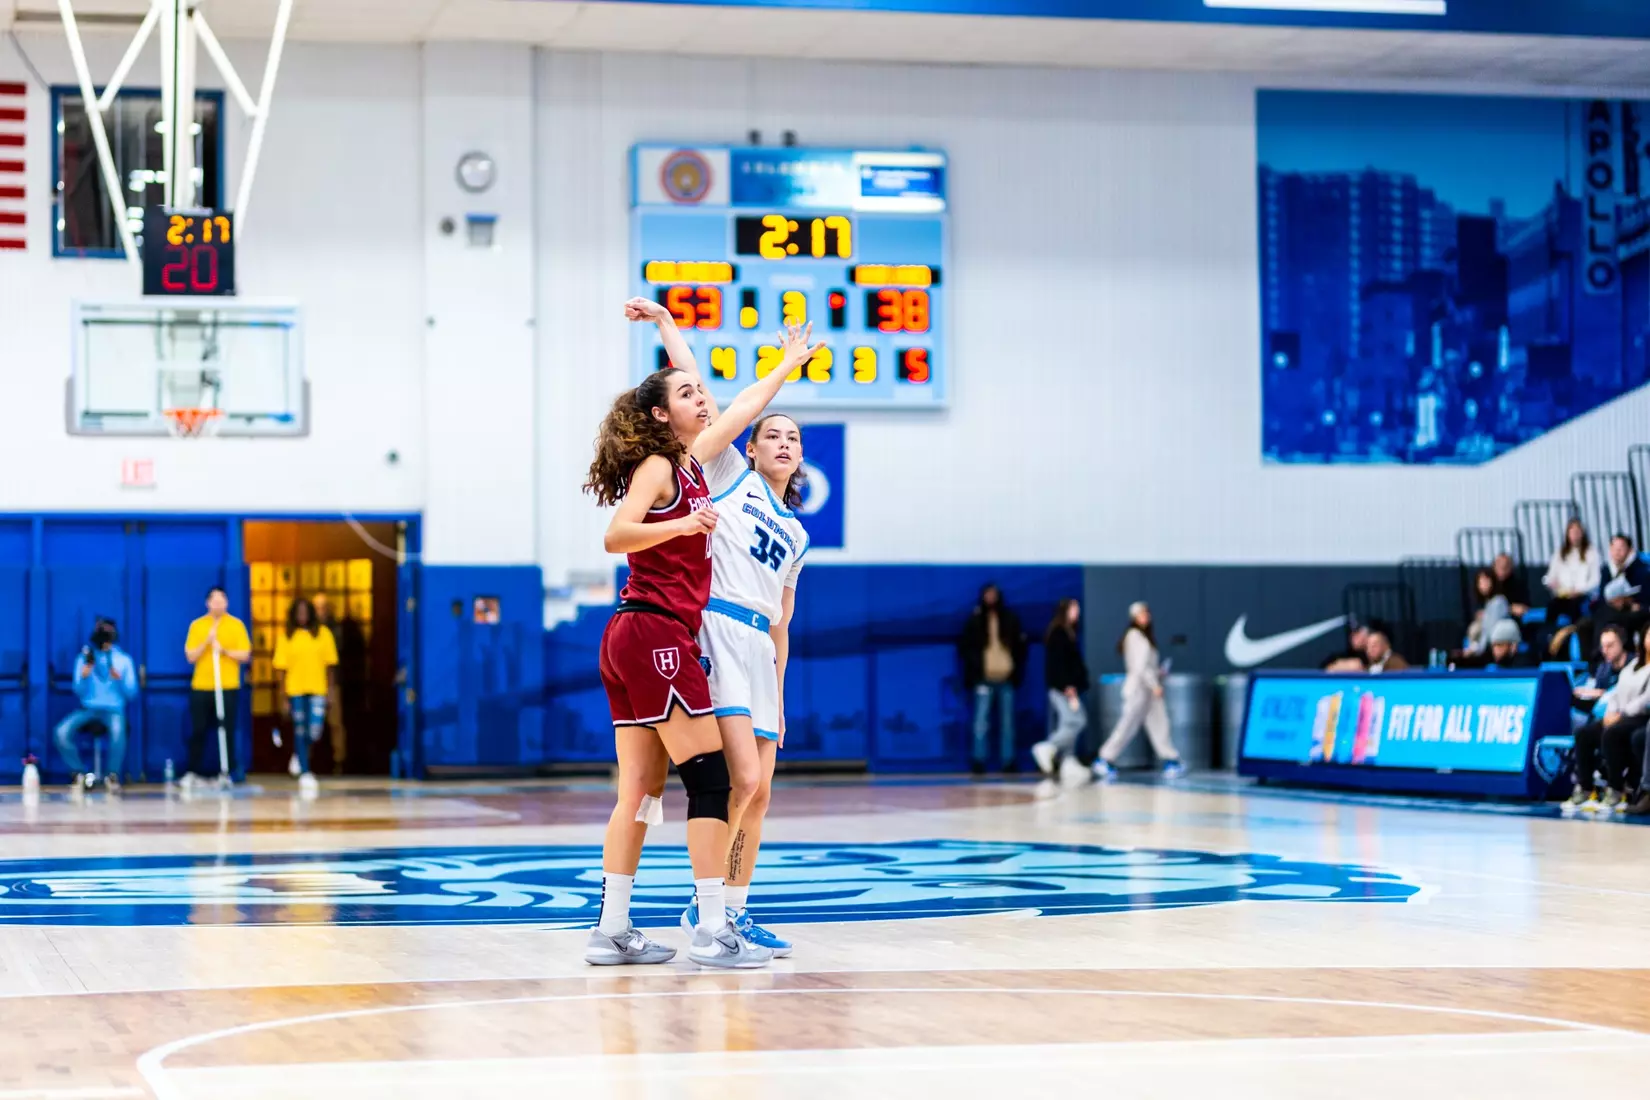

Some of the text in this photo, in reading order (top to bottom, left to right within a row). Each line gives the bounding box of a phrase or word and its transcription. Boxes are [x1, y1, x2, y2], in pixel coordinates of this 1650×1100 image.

[1586, 101, 1613, 288] APOLLO
[167, 214, 230, 246] 2:17
[759, 214, 852, 260] 2:17
[161, 245, 219, 292] 20
[666, 285, 722, 331] 53
[782, 291, 806, 327] 3
[877, 288, 930, 333] 38
[710, 346, 737, 381] 4
[853, 346, 877, 383] 3
[904, 347, 930, 384] 5
[750, 525, 787, 573] 35
[751, 613, 759, 627] C
[660, 651, 675, 670] H
[1387, 704, 1528, 744] FIT FOR ALL TIMES
